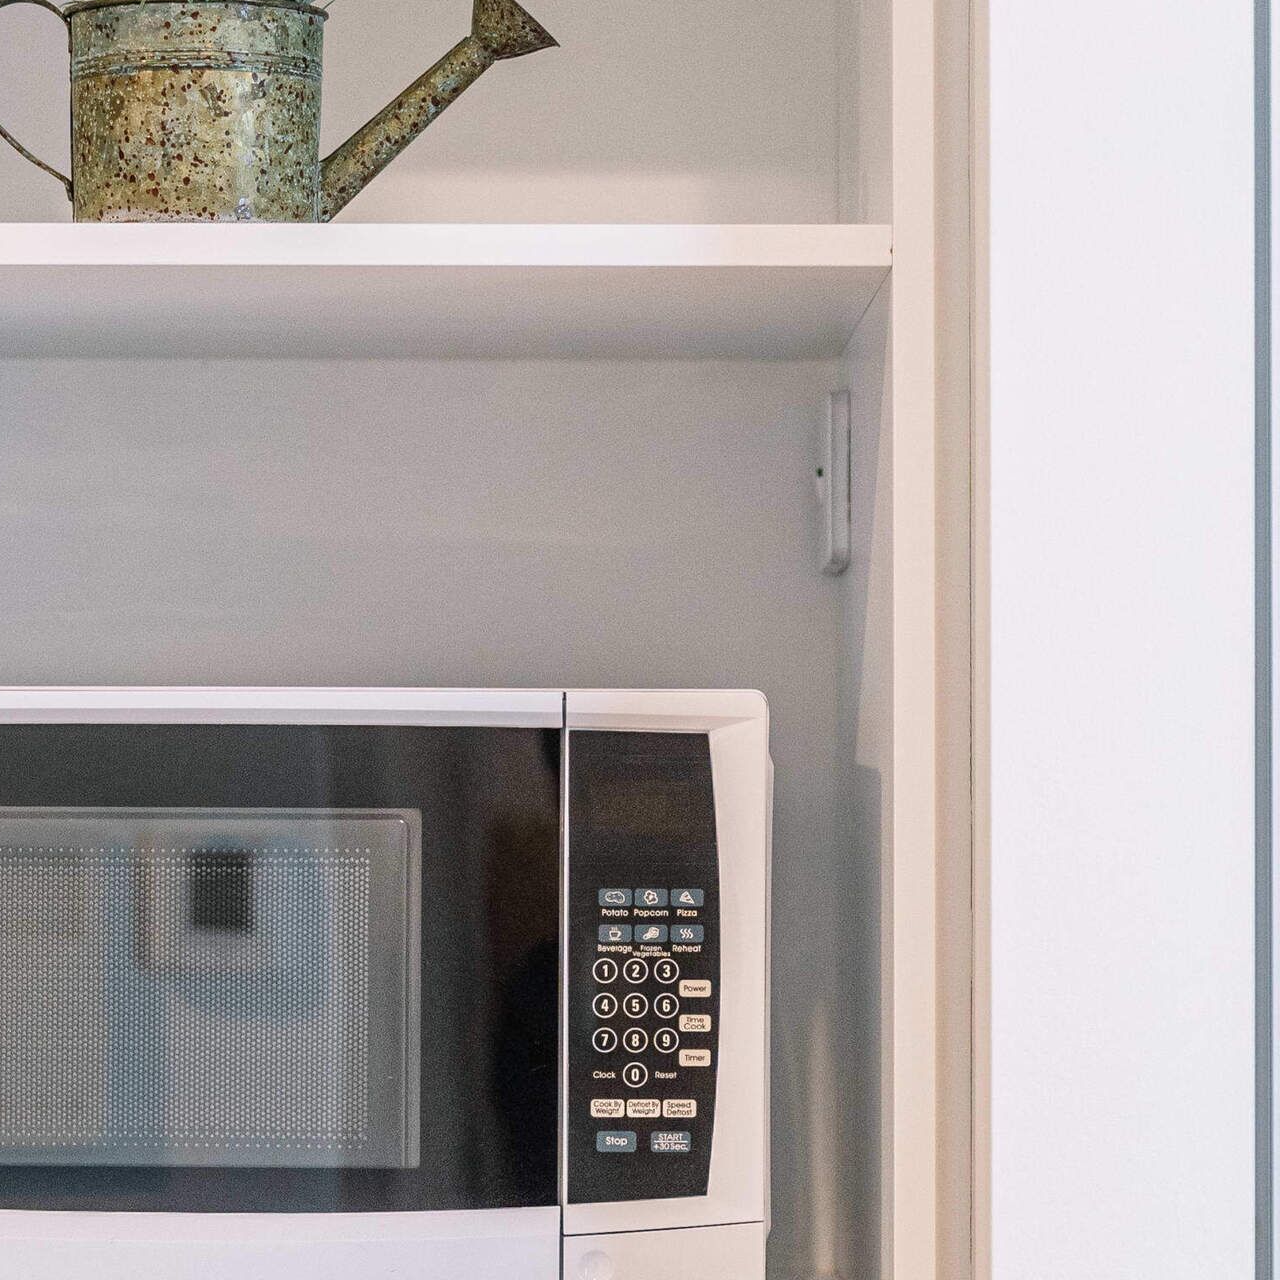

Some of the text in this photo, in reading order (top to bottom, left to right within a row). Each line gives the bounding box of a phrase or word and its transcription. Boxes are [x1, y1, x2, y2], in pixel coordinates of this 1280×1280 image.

[601, 908, 629, 917] Potato
[633, 908, 669, 918] Popcorn
[676, 908, 698, 917] Pizza
[597, 944, 633, 954] Beverage
[672, 944, 702, 952] Reheat
[602, 964, 609, 978] 1
[631, 964, 640, 978] 2
[662, 964, 671, 978] 3
[601, 999, 609, 1012] 4
[631, 999, 640, 1012] 5
[662, 999, 671, 1012] 6
[601, 1033, 609, 1047] 7
[631, 1033, 640, 1047] 8
[662, 1033, 671, 1047] 9
[592, 1071, 617, 1079] Clock
[631, 1068, 640, 1082] 0
[654, 1071, 677, 1079] Reset
[666, 1101, 691, 1109] Speed
[605, 1136, 628, 1146] Stop
